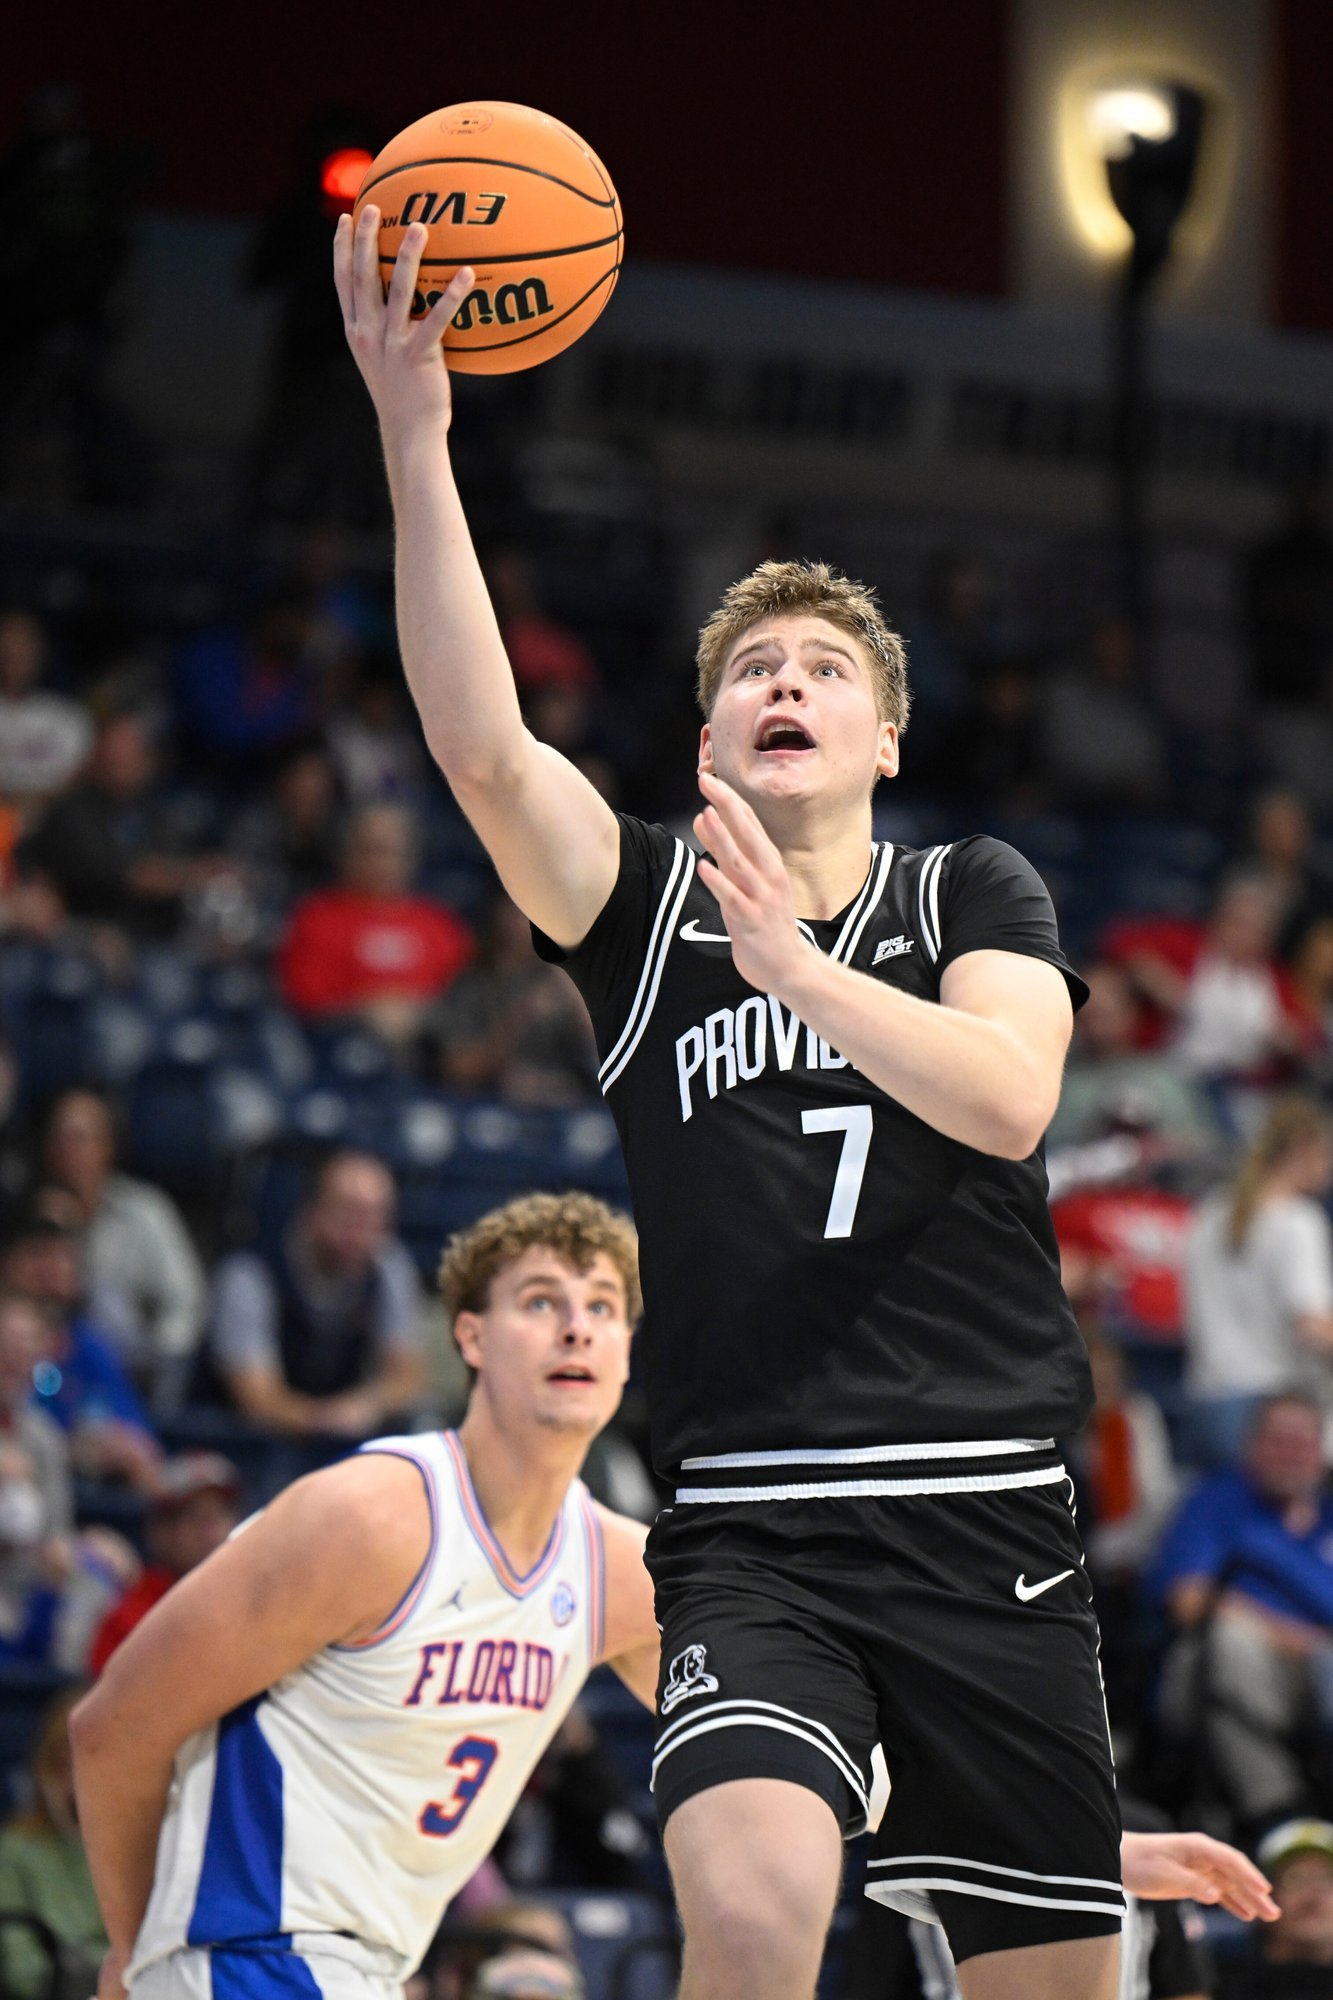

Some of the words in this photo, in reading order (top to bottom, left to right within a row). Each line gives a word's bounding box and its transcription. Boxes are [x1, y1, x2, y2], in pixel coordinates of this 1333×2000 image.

[400, 192, 507, 226] EVO
[873, 940, 915, 960] EAST
[877, 935, 905, 948] BIG
[801, 1104, 874, 1238] 7
[403, 1640, 570, 1711] FLORID
[417, 1731, 499, 1838] 3
